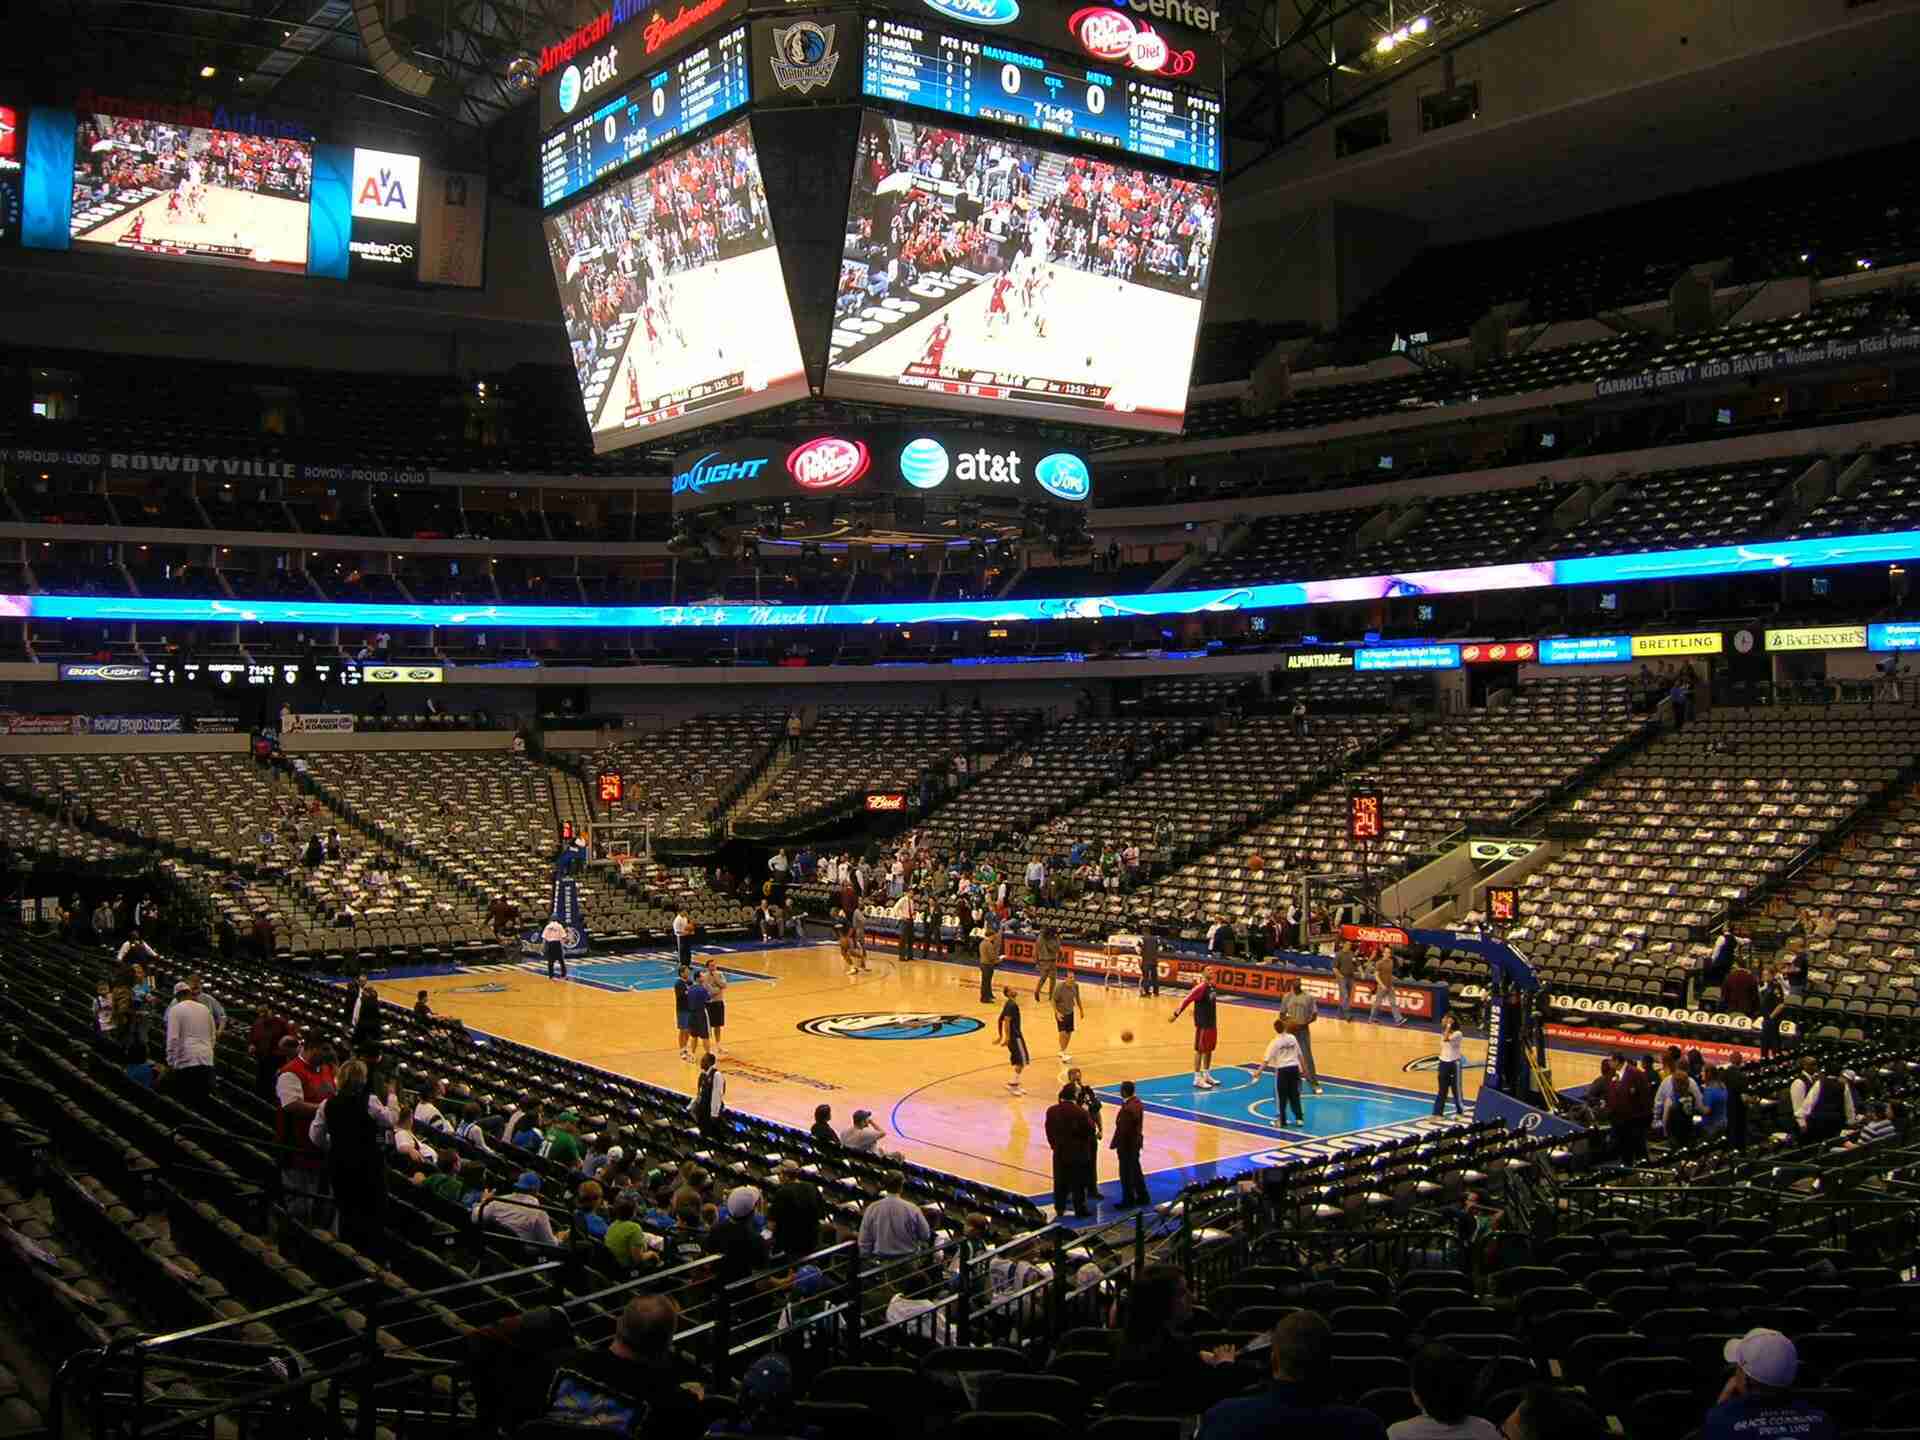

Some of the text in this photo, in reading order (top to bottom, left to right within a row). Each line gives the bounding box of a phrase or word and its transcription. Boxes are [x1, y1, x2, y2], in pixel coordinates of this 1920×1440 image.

[643, 0, 730, 54] Budweis
[1130, 0, 1220, 32] Center
[538, 9, 613, 77] American
[883, 22, 980, 55] PLAYER PTS FLS
[582, 45, 619, 93] at&t
[983, 46, 1045, 71] MAVERICKS
[1001, 63, 1021, 95] 0
[652, 88, 665, 117] 0
[1049, 87, 1057, 99] 1
[1086, 84, 1105, 115] 0
[1140, 84, 1174, 102] PLAYER
[1187, 96, 1204, 109] PTS
[604, 115, 617, 143] 0
[349, 241, 414, 259] metroPCS
[1733, 353, 1774, 374] HAVEN
[17, 450, 60, 464] PROUD
[66, 453, 102, 466] LOUD
[110, 453, 297, 480] ROWDYVILLE
[304, 467, 346, 480] ROWDY
[351, 468, 389, 482] PROUD
[394, 472, 425, 484] LOUD
[672, 458, 769, 495] UD LIGHT
[956, 447, 1021, 484] at&t
[1639, 637, 1714, 650] BREITLING
[68, 668, 142, 676] BUD LIGHT
[221, 671, 232, 684] 0
[285, 672, 296, 684] 0
[248, 665, 275, 675] 71:42
[602, 784, 618, 799] 24
[1356, 812, 1376, 836] 24
[1009, 943, 1034, 958] 103
[1216, 968, 1264, 990] 103.3
[1487, 1005, 1502, 1075] SAMSUNG
